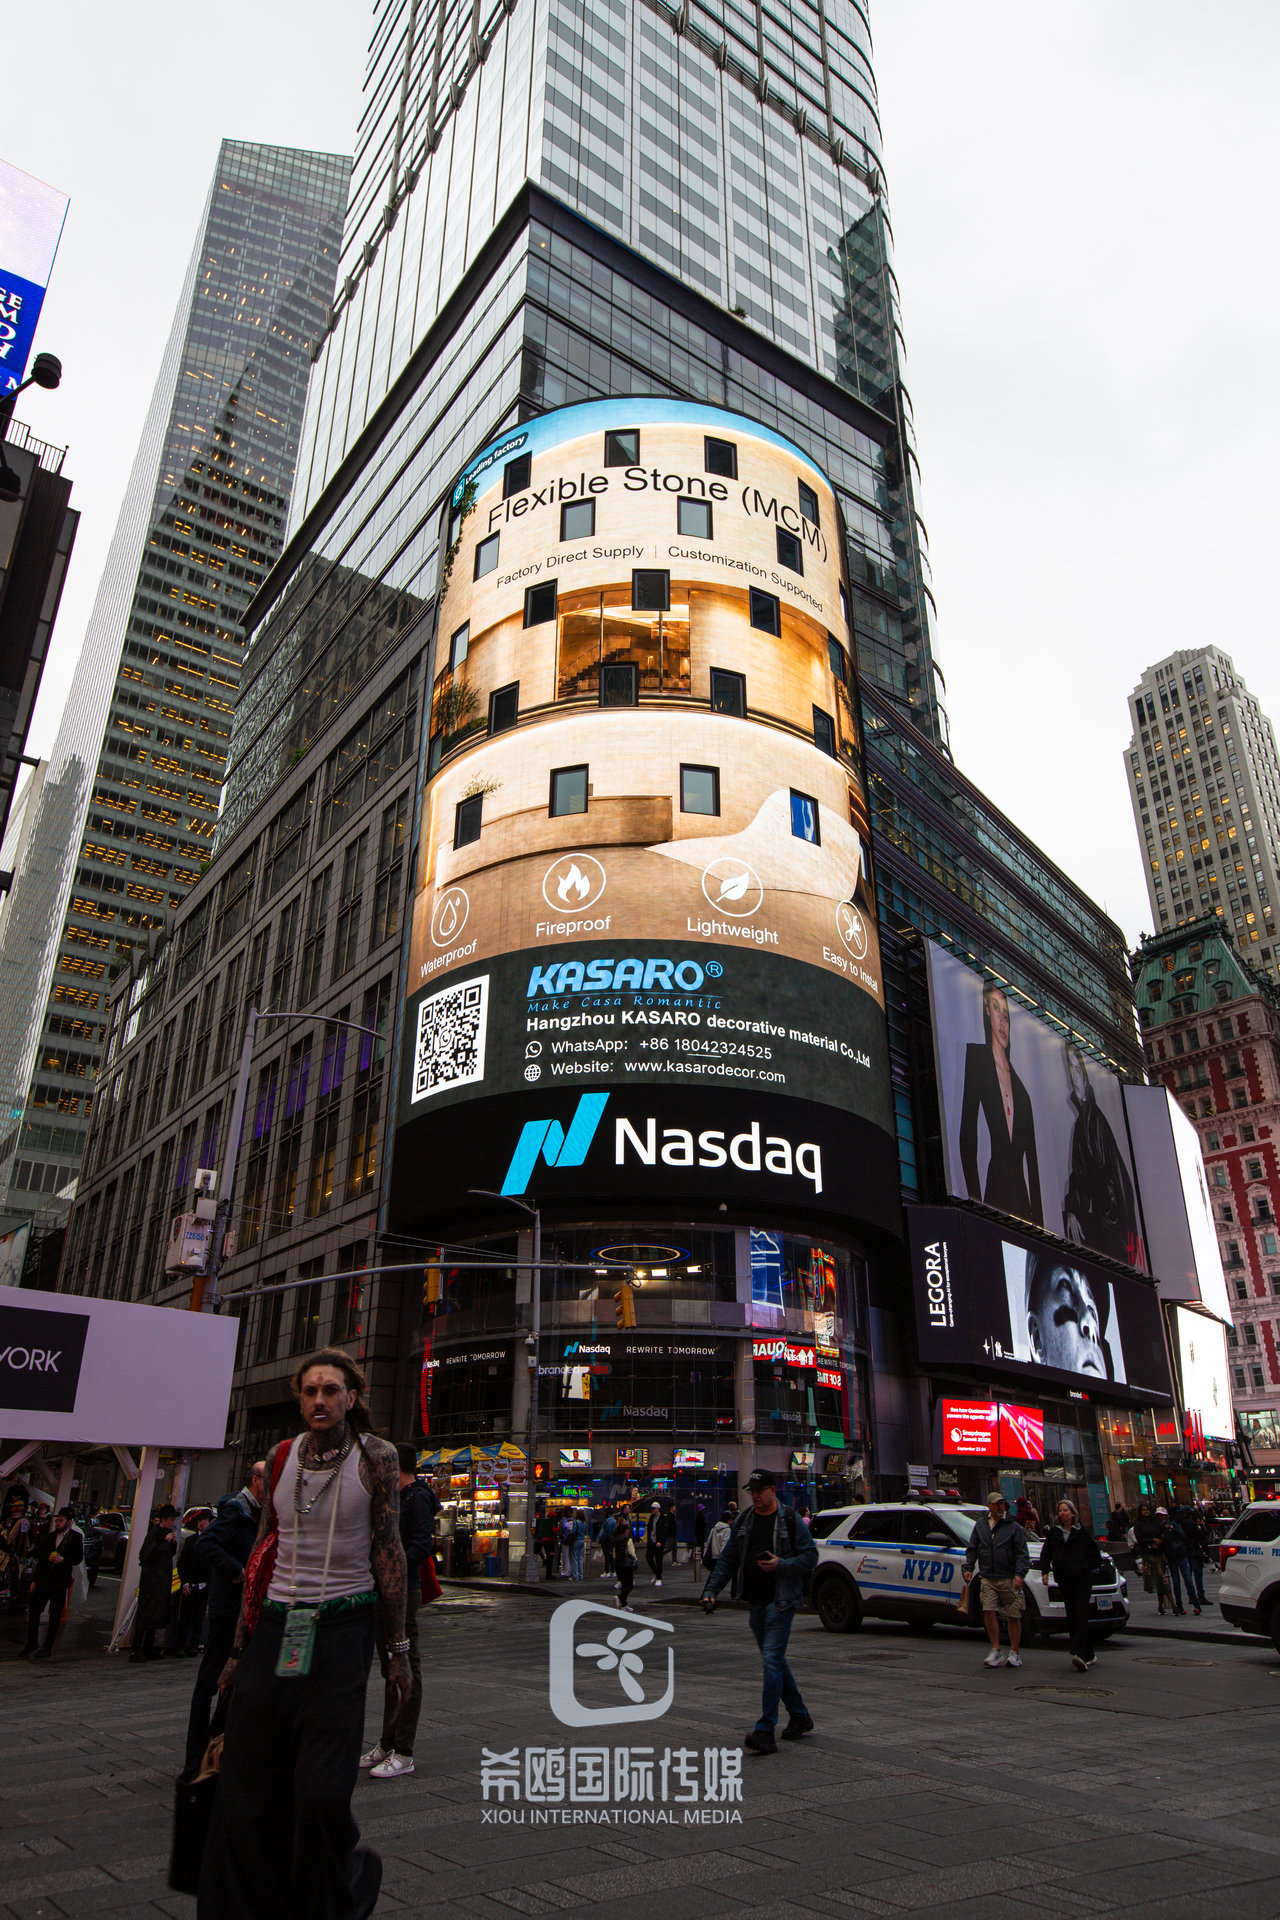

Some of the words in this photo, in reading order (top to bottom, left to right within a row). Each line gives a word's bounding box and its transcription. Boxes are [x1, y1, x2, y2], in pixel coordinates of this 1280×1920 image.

[465, 456, 493, 485] Leading
[494, 436, 525, 459] factory
[488, 473, 609, 533] Flexible
[623, 467, 728, 501] Stone
[742, 486, 829, 563] (MCM)
[497, 560, 542, 588] Factory
[546, 548, 588, 570] Direct
[593, 545, 644, 561] Supply
[668, 545, 767, 579] Customization
[770, 570, 824, 613] Supported
[535, 916, 612, 938] Fireproof
[687, 917, 779, 945] Lightweight
[420, 940, 477, 978] Waterproof
[822, 946, 848, 968] Easy
[849, 959, 860, 976] to
[860, 966, 879, 994] Install
[527, 999, 570, 1013] Make
[581, 996, 623, 1008] Casa
[634, 995, 722, 1010] Romantic
[526, 1012, 615, 1033] Hangzhou
[621, 1010, 701, 1027] KASARO
[706, 1014, 786, 1039] decorative
[788, 1028, 838, 1053] material
[551, 1037, 629, 1056] WhatsApp:
[639, 1038, 669, 1051] +86
[674, 1038, 773, 1060] 18042324525
[550, 1060, 615, 1076] Website:
[625, 1060, 786, 1084] www.kasarodecor.com
[615, 1117, 823, 1194] Nasdaq
[924, 1241, 947, 1327] LEGORA
[445, 1355, 468, 1365] REWRITE
[470, 1351, 506, 1361] TOMORROW
[579, 1344, 611, 1354] Nasdaq
[626, 1346, 664, 1354] REWRITE
[668, 1347, 716, 1355] TOMORROW
[817, 1357, 839, 1368] REWRITE
[623, 1405, 668, 1419] Nasdaq
[902, 1558, 955, 1584] NYPD
